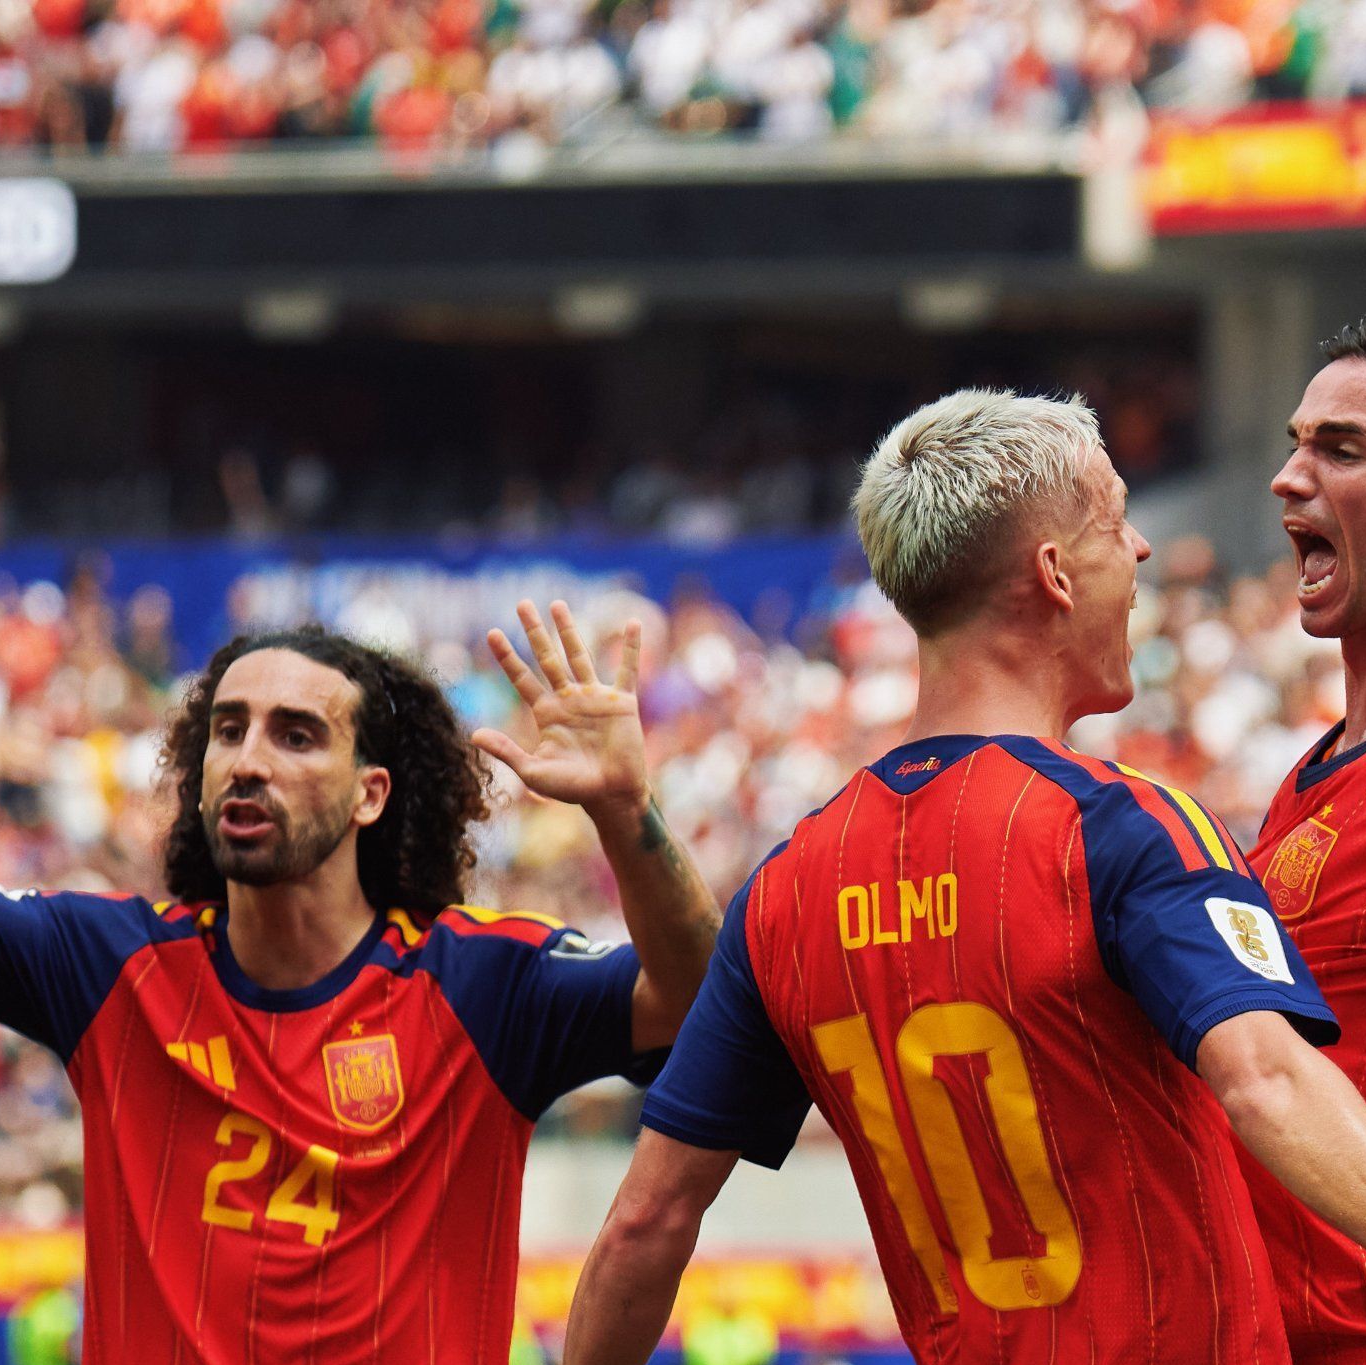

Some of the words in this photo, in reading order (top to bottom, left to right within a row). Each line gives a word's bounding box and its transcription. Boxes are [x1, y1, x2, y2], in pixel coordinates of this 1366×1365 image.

[837, 872, 958, 950] OLMO
[201, 1110, 340, 1247] 24
[811, 1001, 1083, 1315] 10
